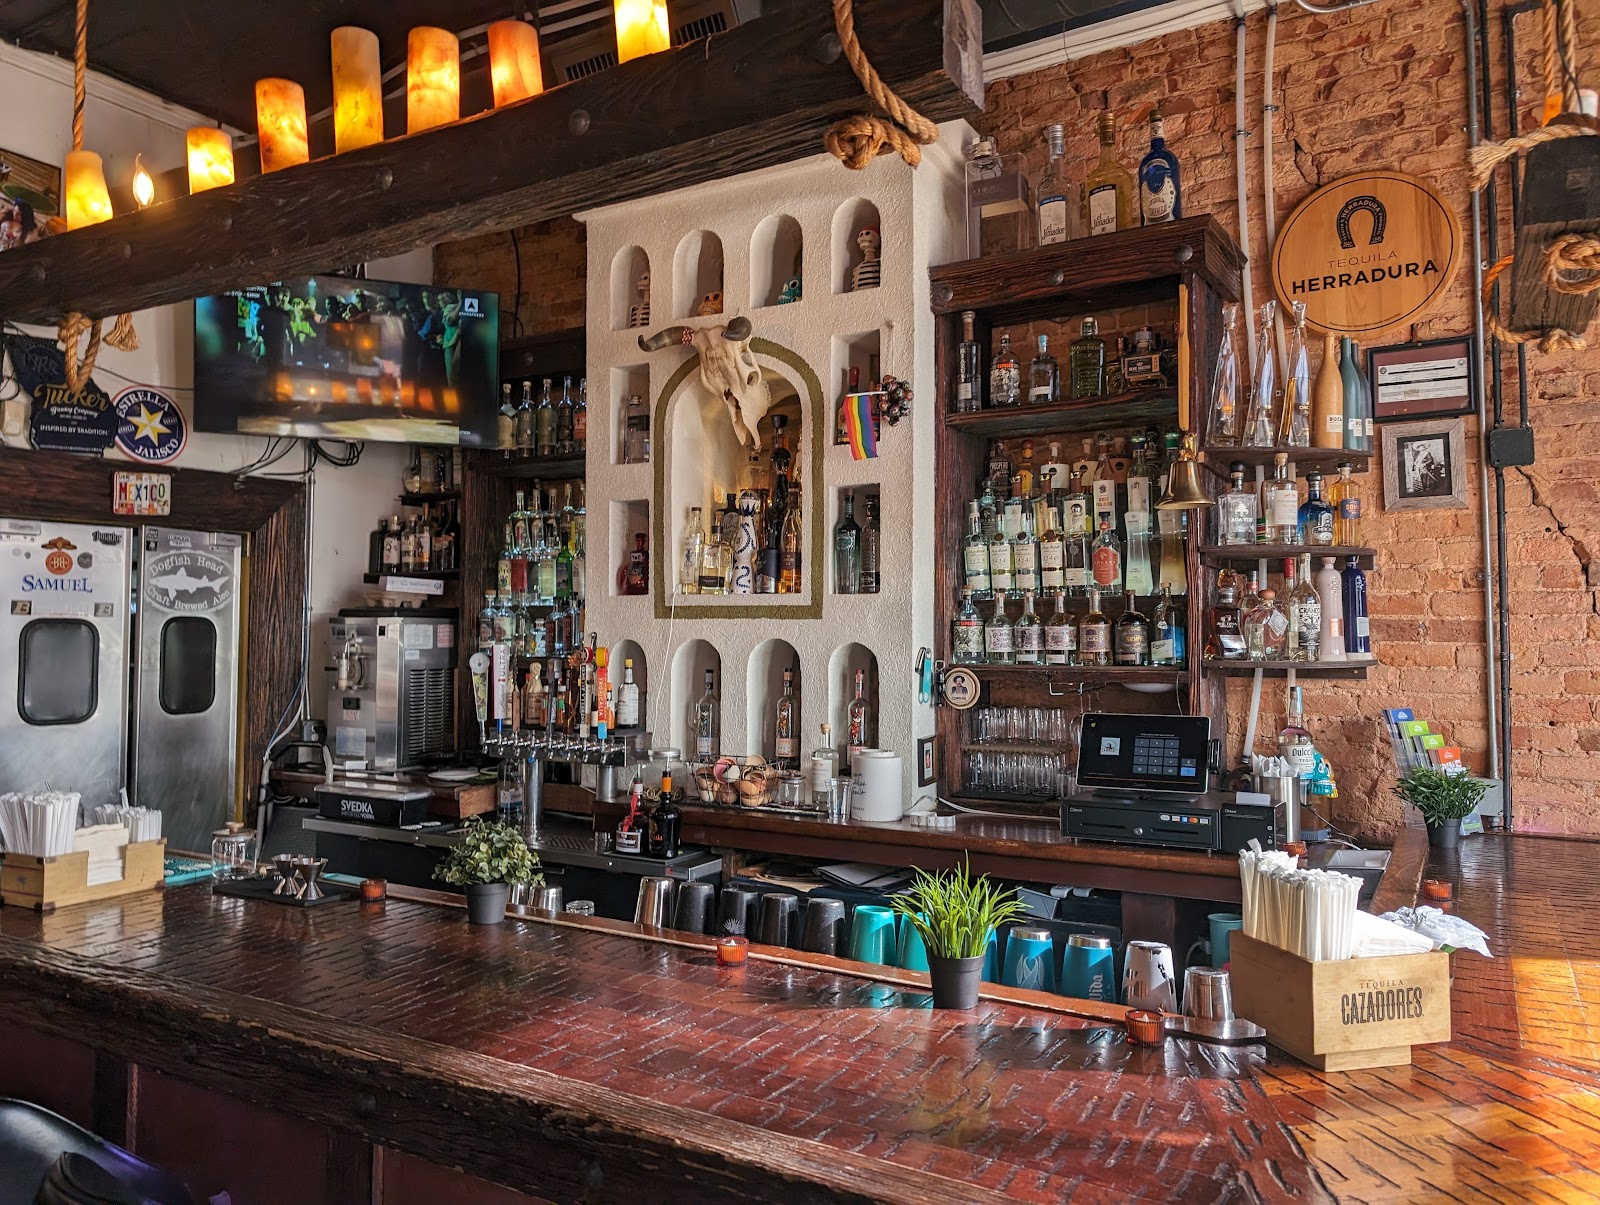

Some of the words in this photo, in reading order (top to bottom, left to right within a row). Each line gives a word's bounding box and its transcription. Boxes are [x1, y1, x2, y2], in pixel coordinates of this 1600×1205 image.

[1327, 251, 1398, 269] TEQUILA
[1292, 259, 1439, 295] HERRADURA
[33, 383, 109, 411] Tucker
[116, 391, 169, 419] ESTRELLA
[40, 424, 68, 432] INSPIRED
[77, 427, 109, 436] TRADITION
[135, 438, 179, 459] JALISCO
[150, 555, 191, 576] Dogfish
[197, 556, 224, 575] Head
[21, 575, 93, 593] SAMUEL
[147, 586, 170, 606] Craft
[174, 600, 208, 610] Brewed
[213, 590, 230, 606] Ales
[341, 799, 374, 814] SVEDKA
[1359, 979, 1404, 989] TEQUILA
[1341, 987, 1423, 1025] CAZADORES
